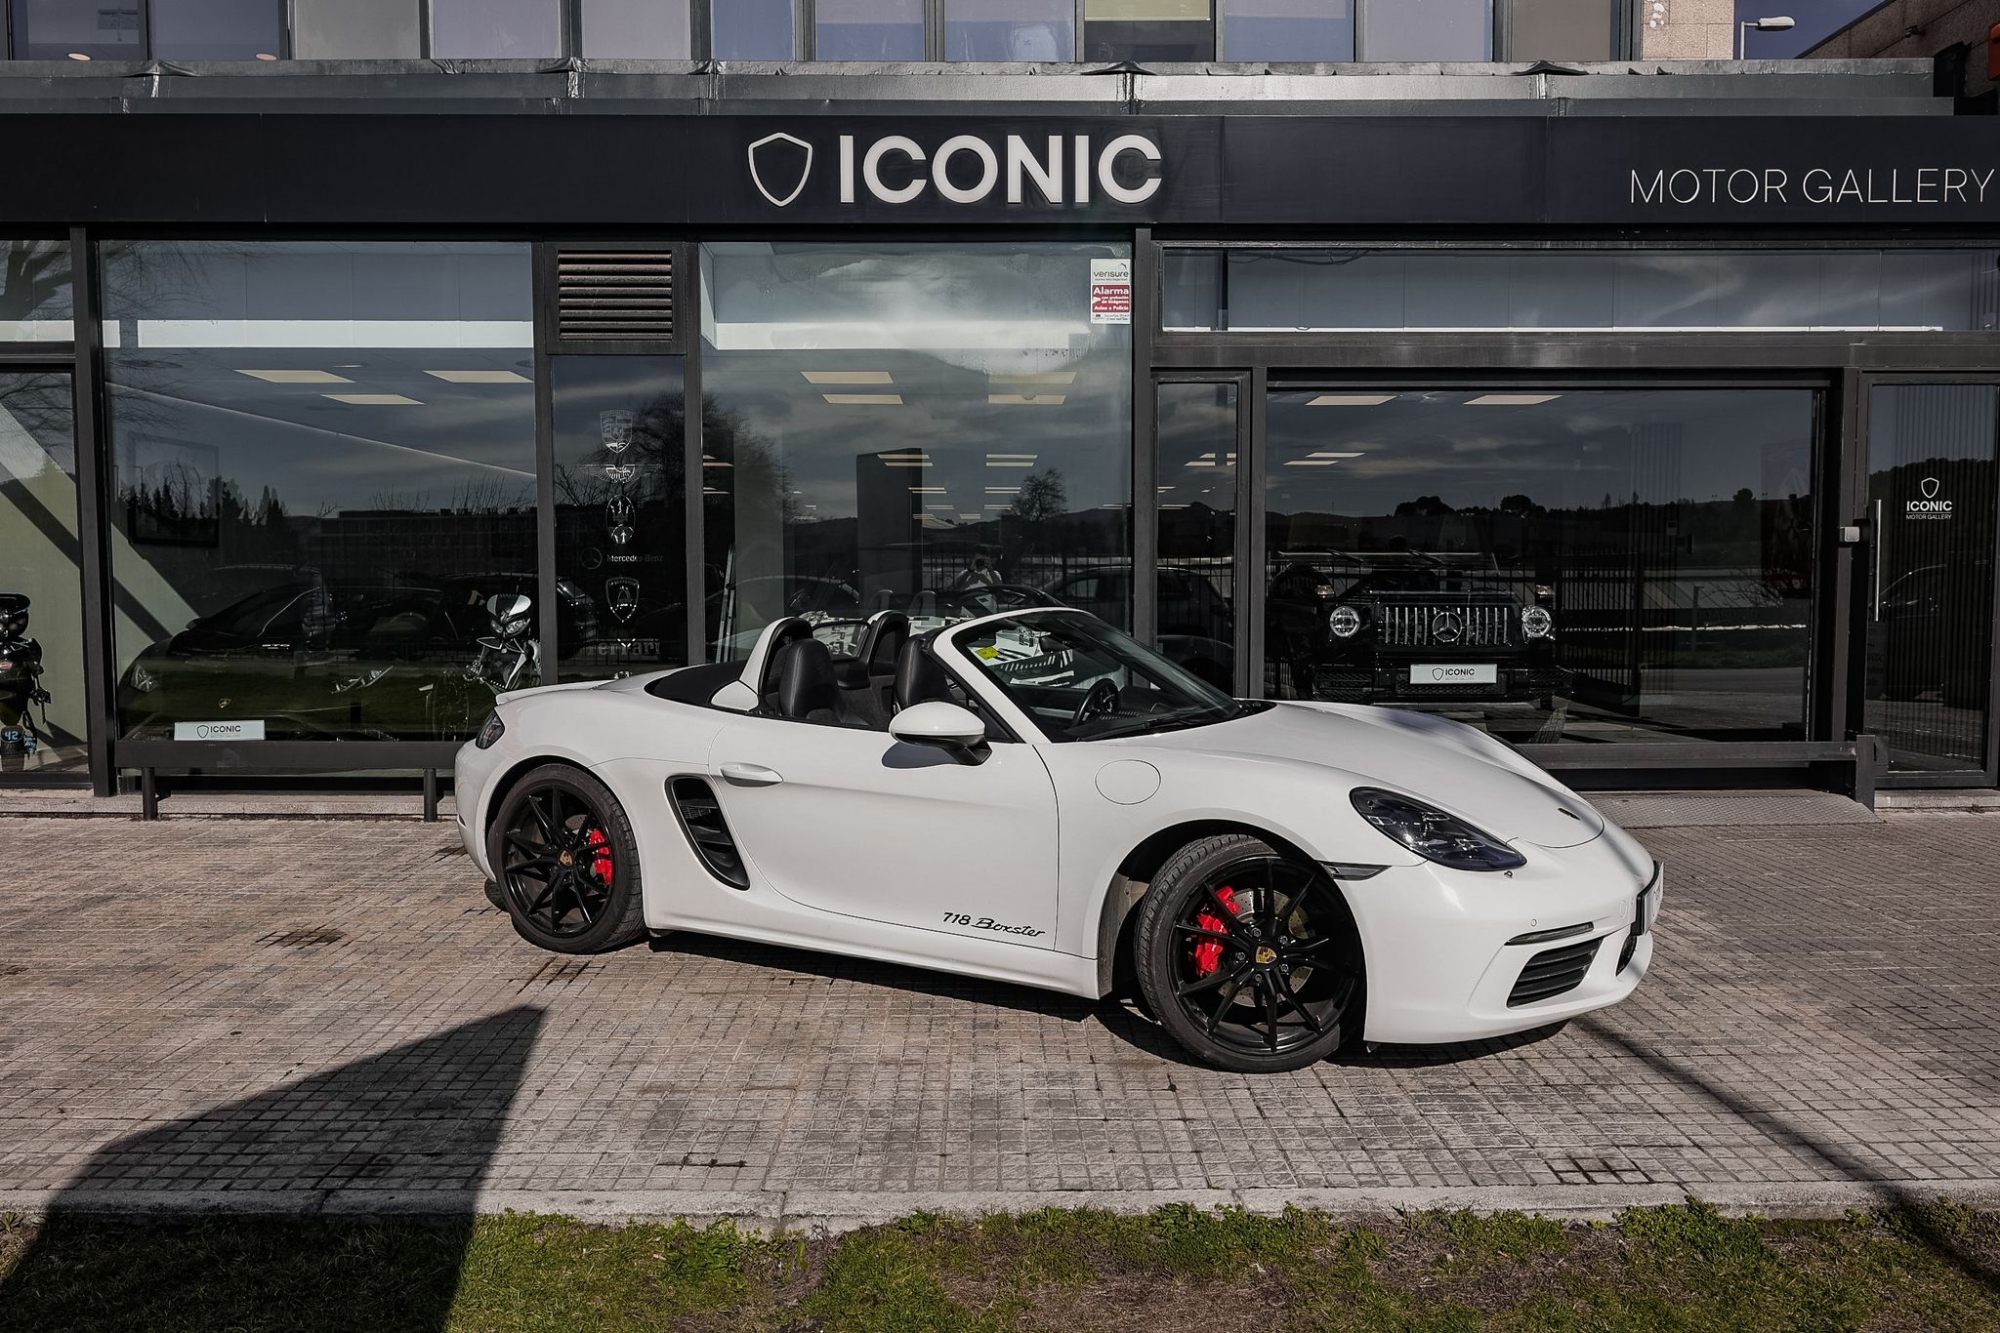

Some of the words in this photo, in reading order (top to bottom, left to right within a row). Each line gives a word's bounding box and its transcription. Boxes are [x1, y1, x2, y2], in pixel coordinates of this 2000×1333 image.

[839, 134, 1162, 204] ICONIC
[1630, 168, 1788, 203] MOTOR
[1803, 168, 1995, 203] GALLERY
[1093, 270, 1129, 278] verisure
[1093, 286, 1129, 295] Alarma
[1906, 500, 1953, 512] ICONIC
[1445, 668, 1475, 676] ICONIC
[210, 725, 241, 733] ICONIC
[4, 730, 19, 741] 42
[943, 912, 971, 926] 718
[971, 917, 1046, 937] Boxster
